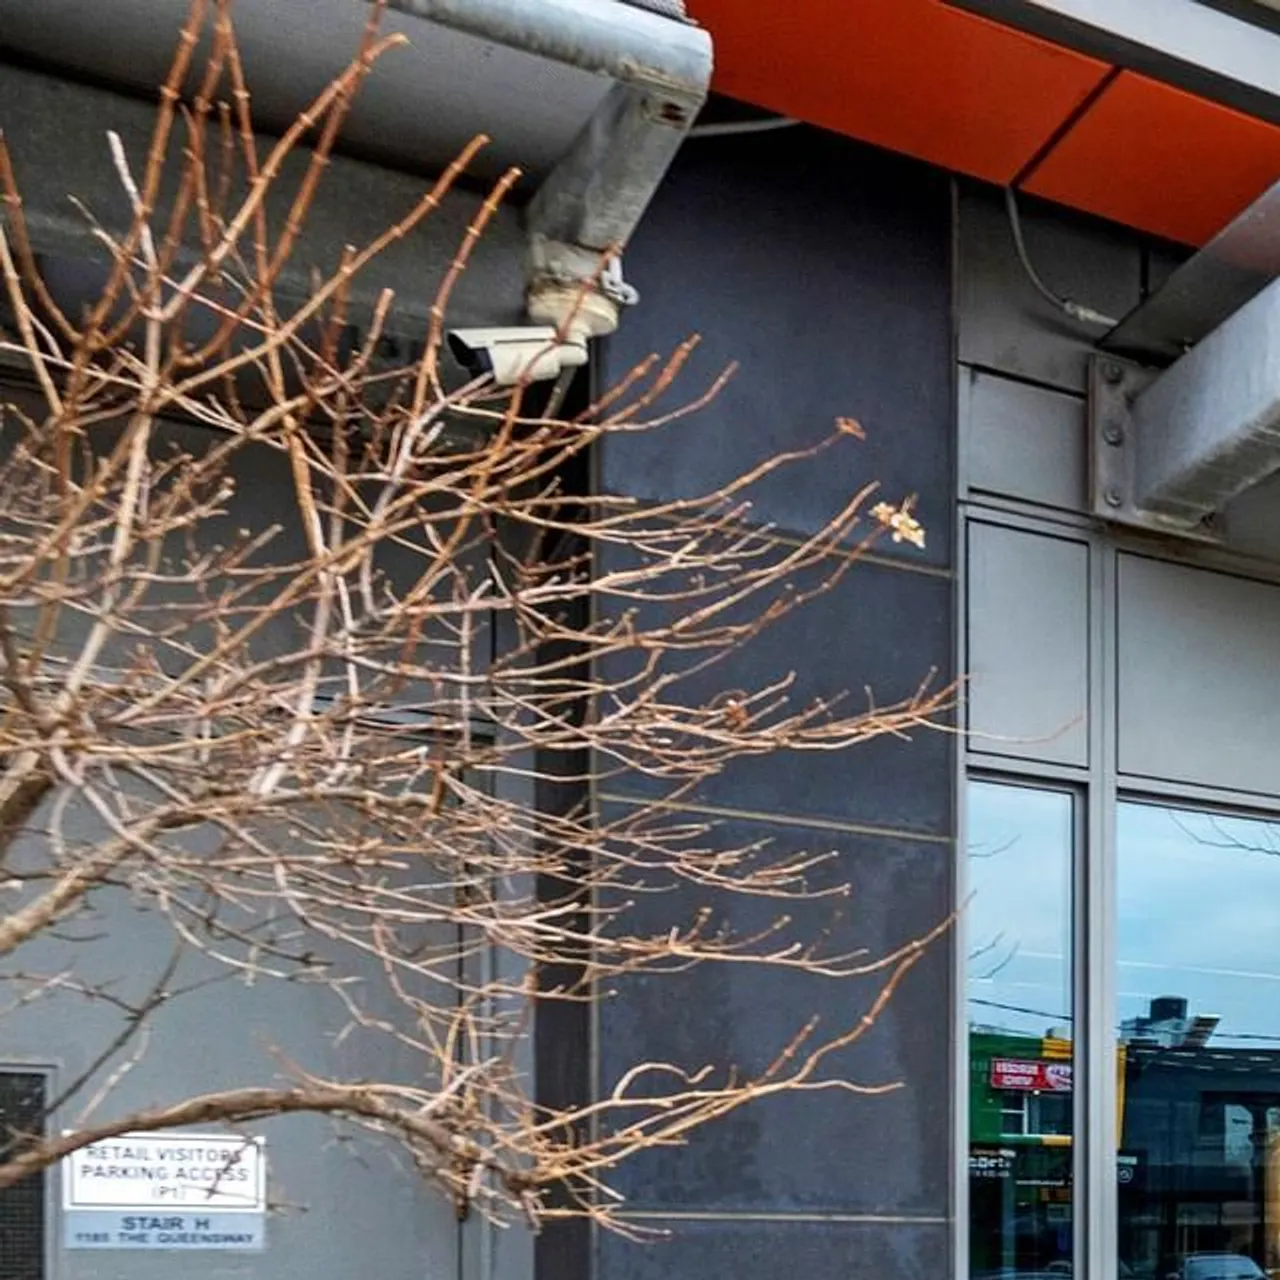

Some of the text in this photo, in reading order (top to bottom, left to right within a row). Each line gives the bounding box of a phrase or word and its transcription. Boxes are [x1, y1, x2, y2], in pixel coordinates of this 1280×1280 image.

[86, 1146, 242, 1163] RETAIL VISITORS
[81, 1165, 249, 1181] PARKING ACCESS
[122, 1216, 210, 1231] STAIR H
[118, 1233, 149, 1243] THE
[158, 1233, 254, 1244] QUEENSWAY
